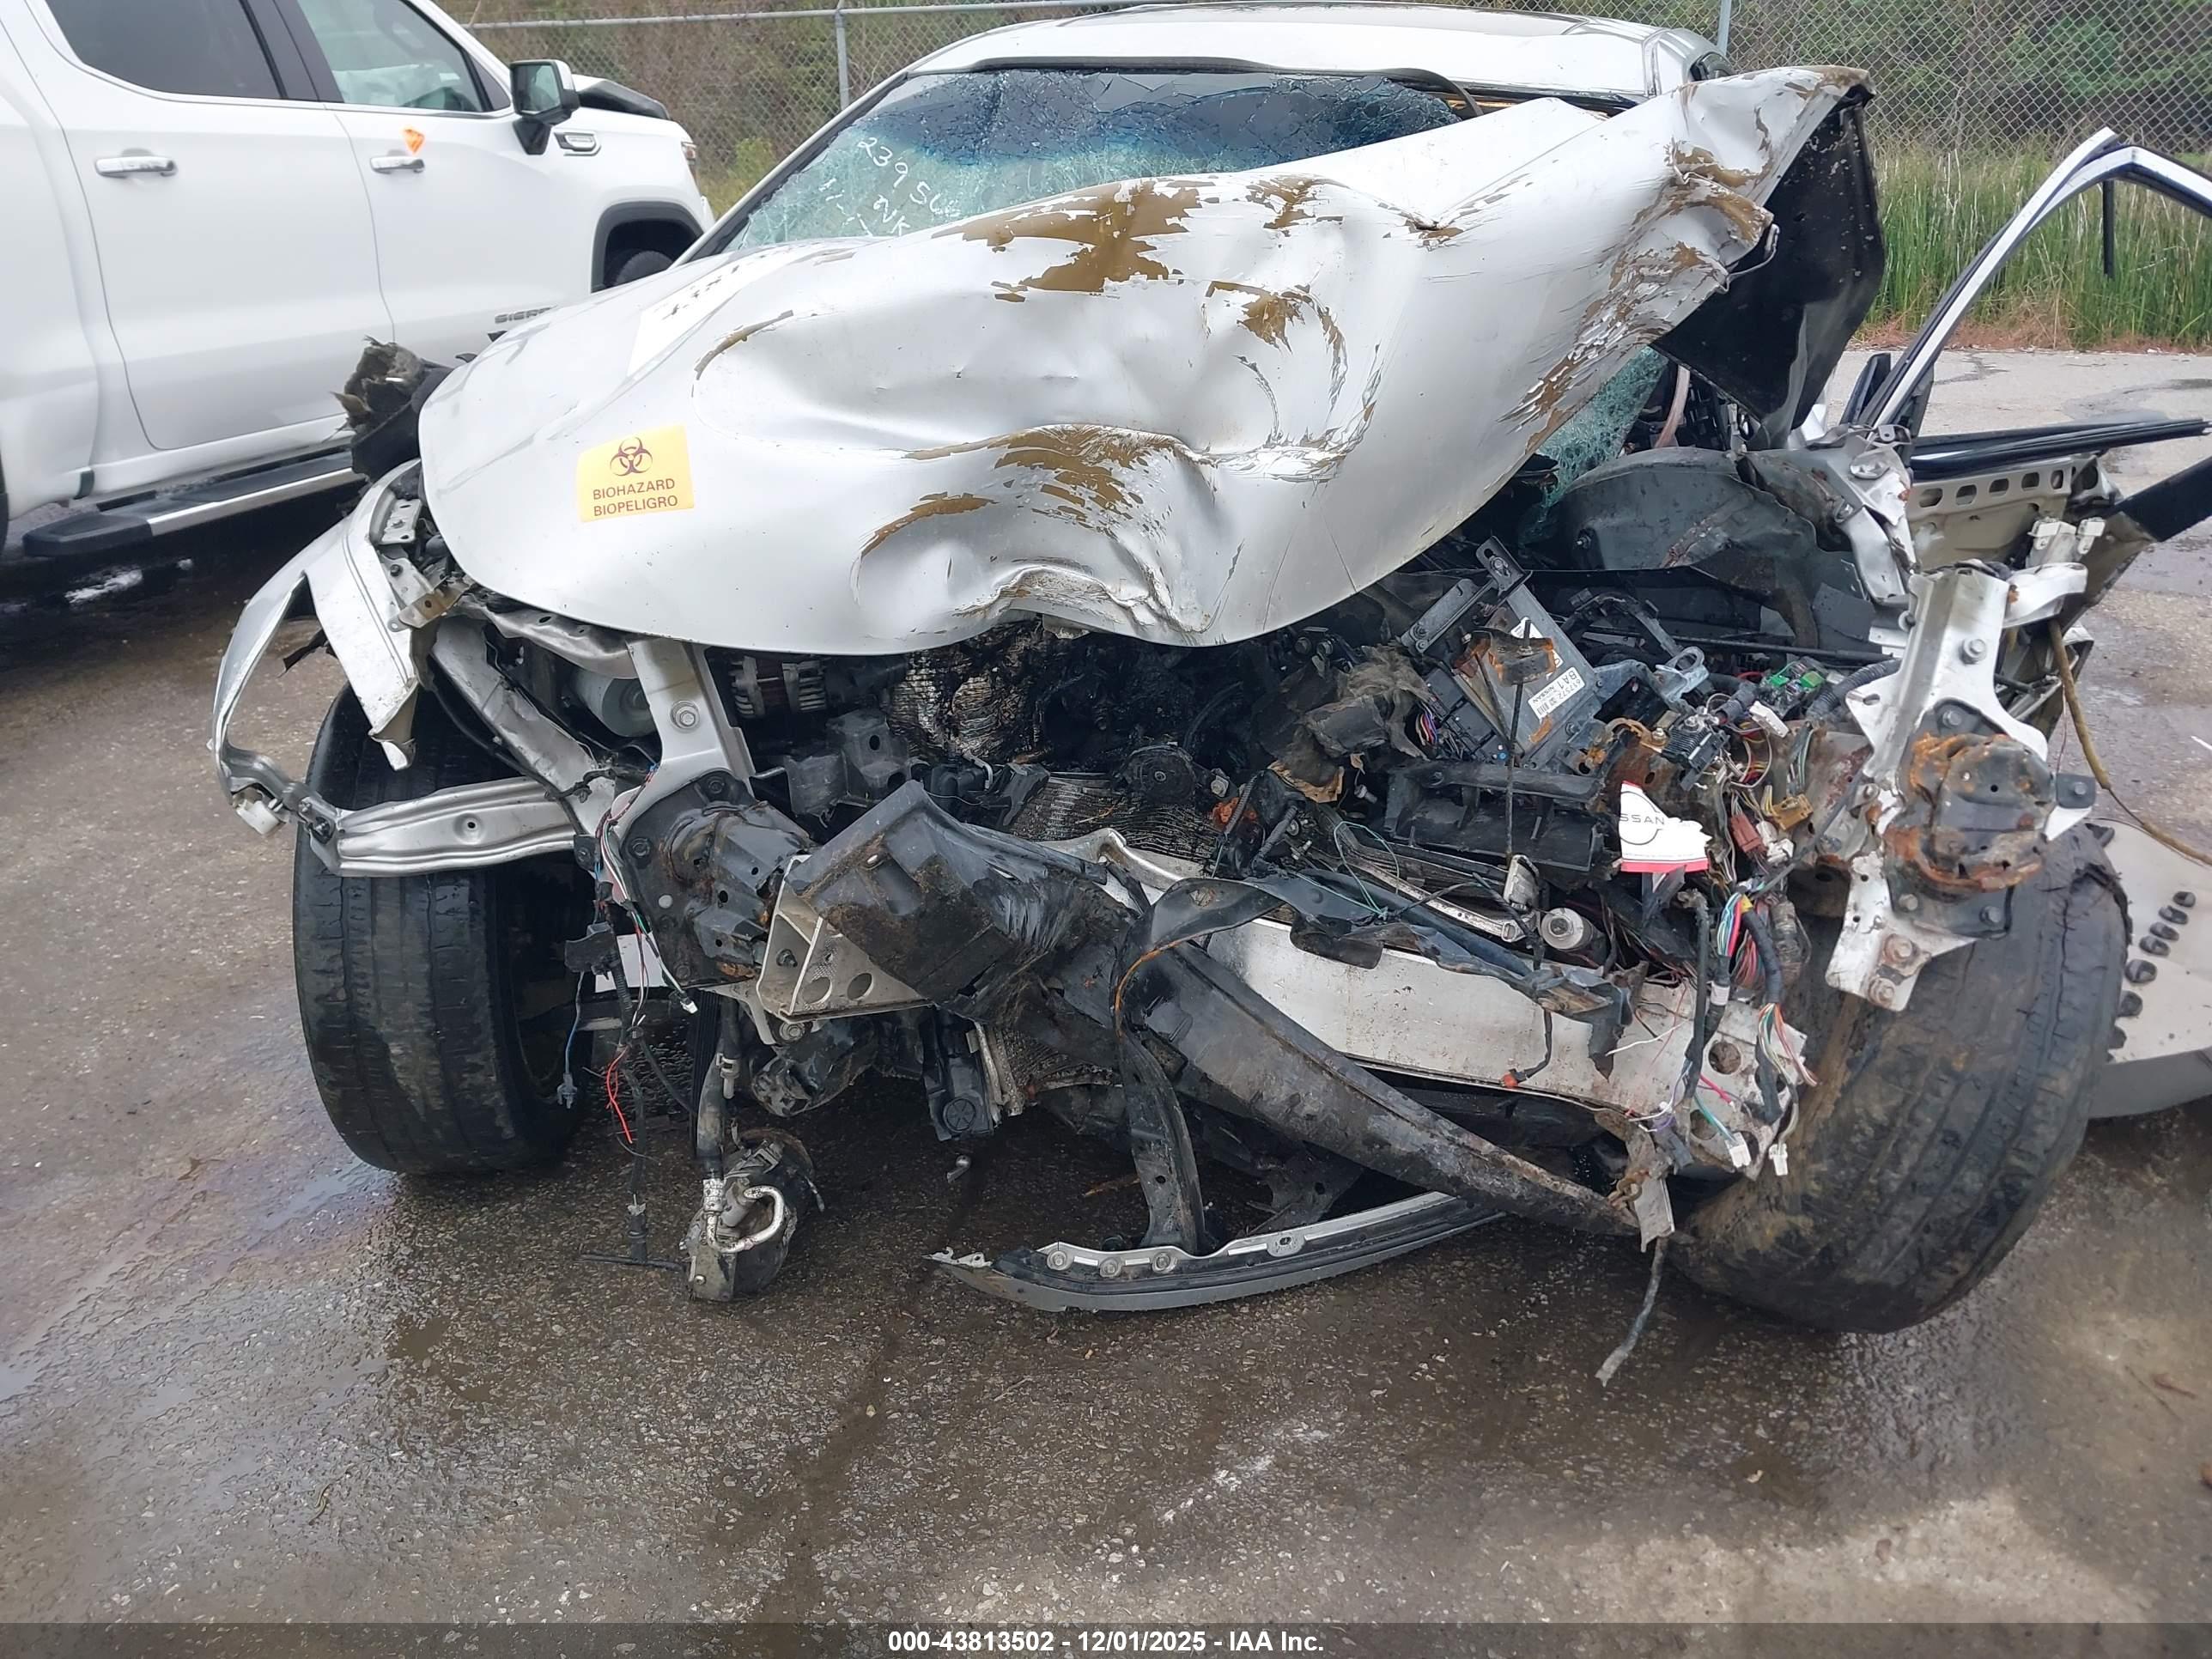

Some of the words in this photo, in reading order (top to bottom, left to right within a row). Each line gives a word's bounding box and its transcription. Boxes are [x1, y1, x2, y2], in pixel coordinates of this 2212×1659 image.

[495, 304, 558, 323] SIER
[592, 477, 676, 500] BIOHAZARD
[593, 495, 678, 516] BIOPELIGRO
